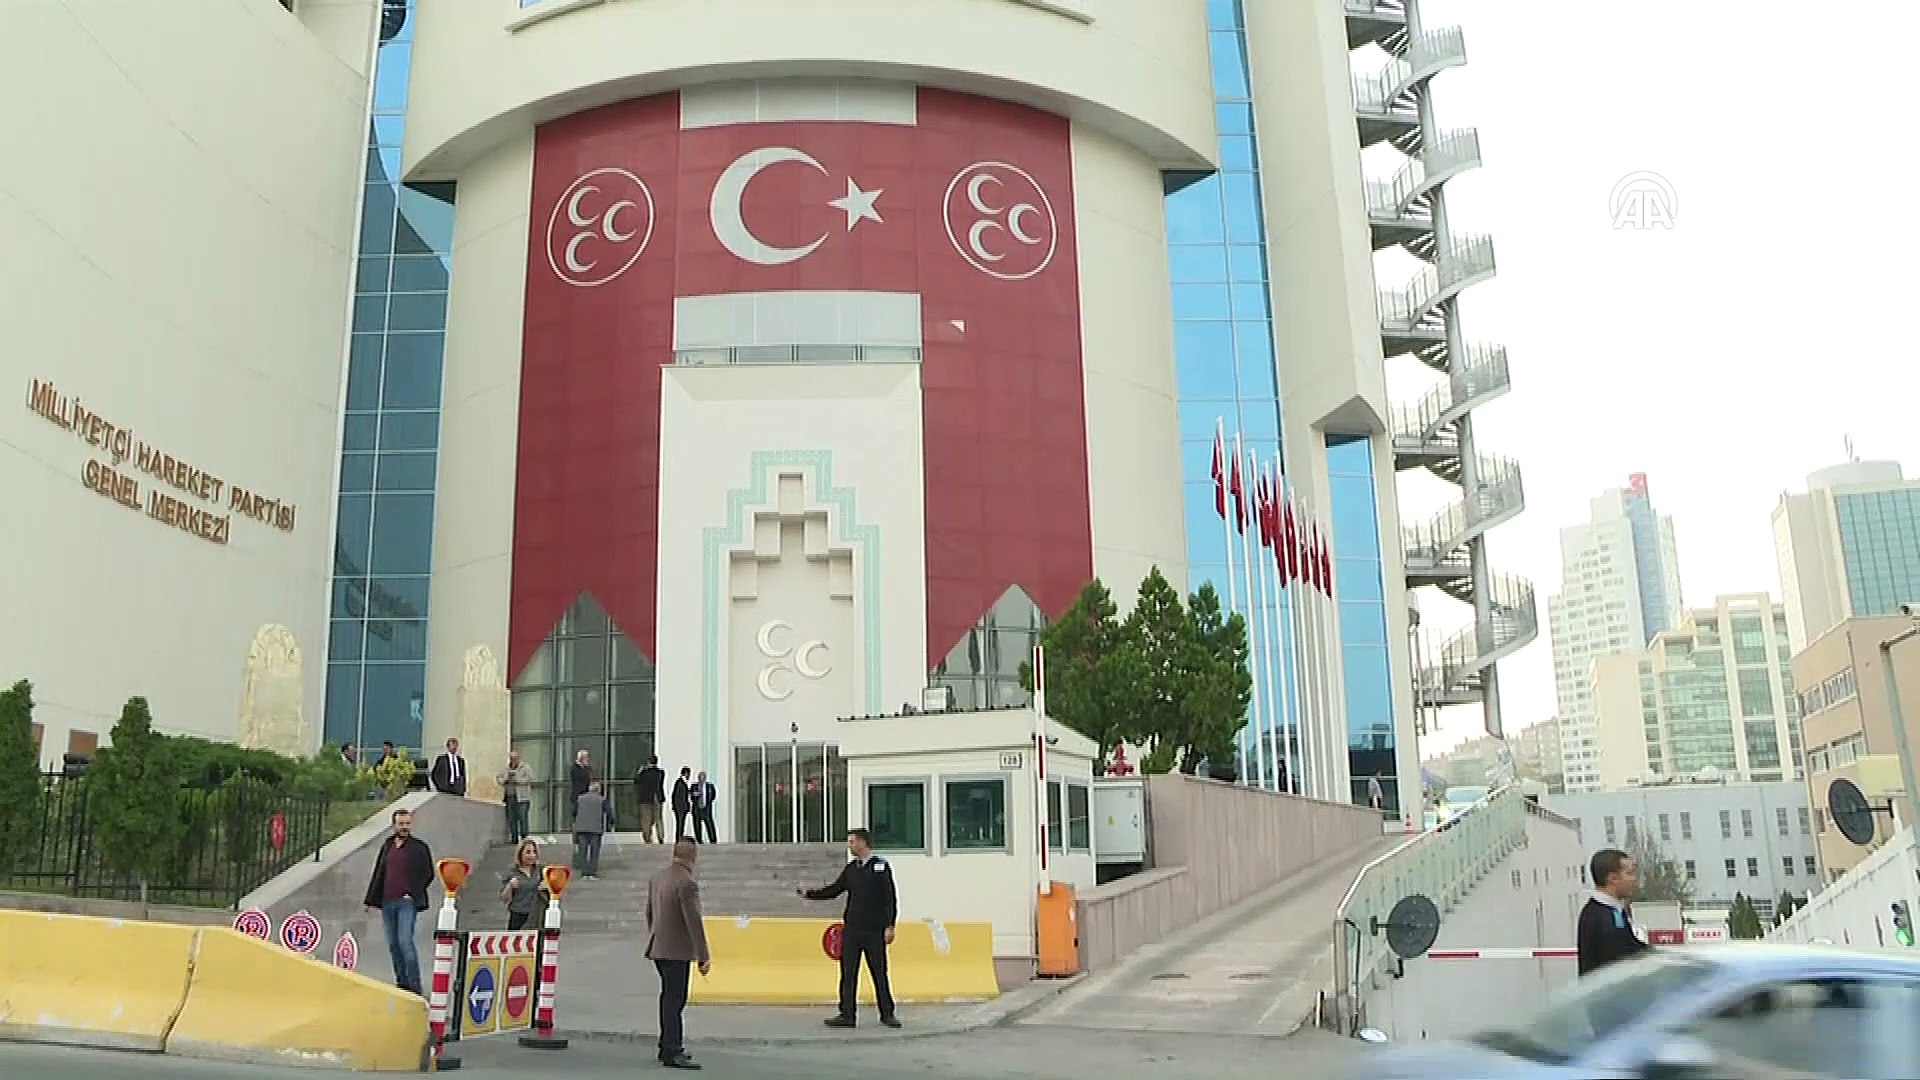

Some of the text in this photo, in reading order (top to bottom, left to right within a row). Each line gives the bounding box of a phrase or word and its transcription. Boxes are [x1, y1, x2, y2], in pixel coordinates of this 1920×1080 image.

[27, 378, 297, 533] MİLLİYETÇİ HAREKET PARTİSİ
[82, 458, 232, 545] GENEL MERKEZİ
